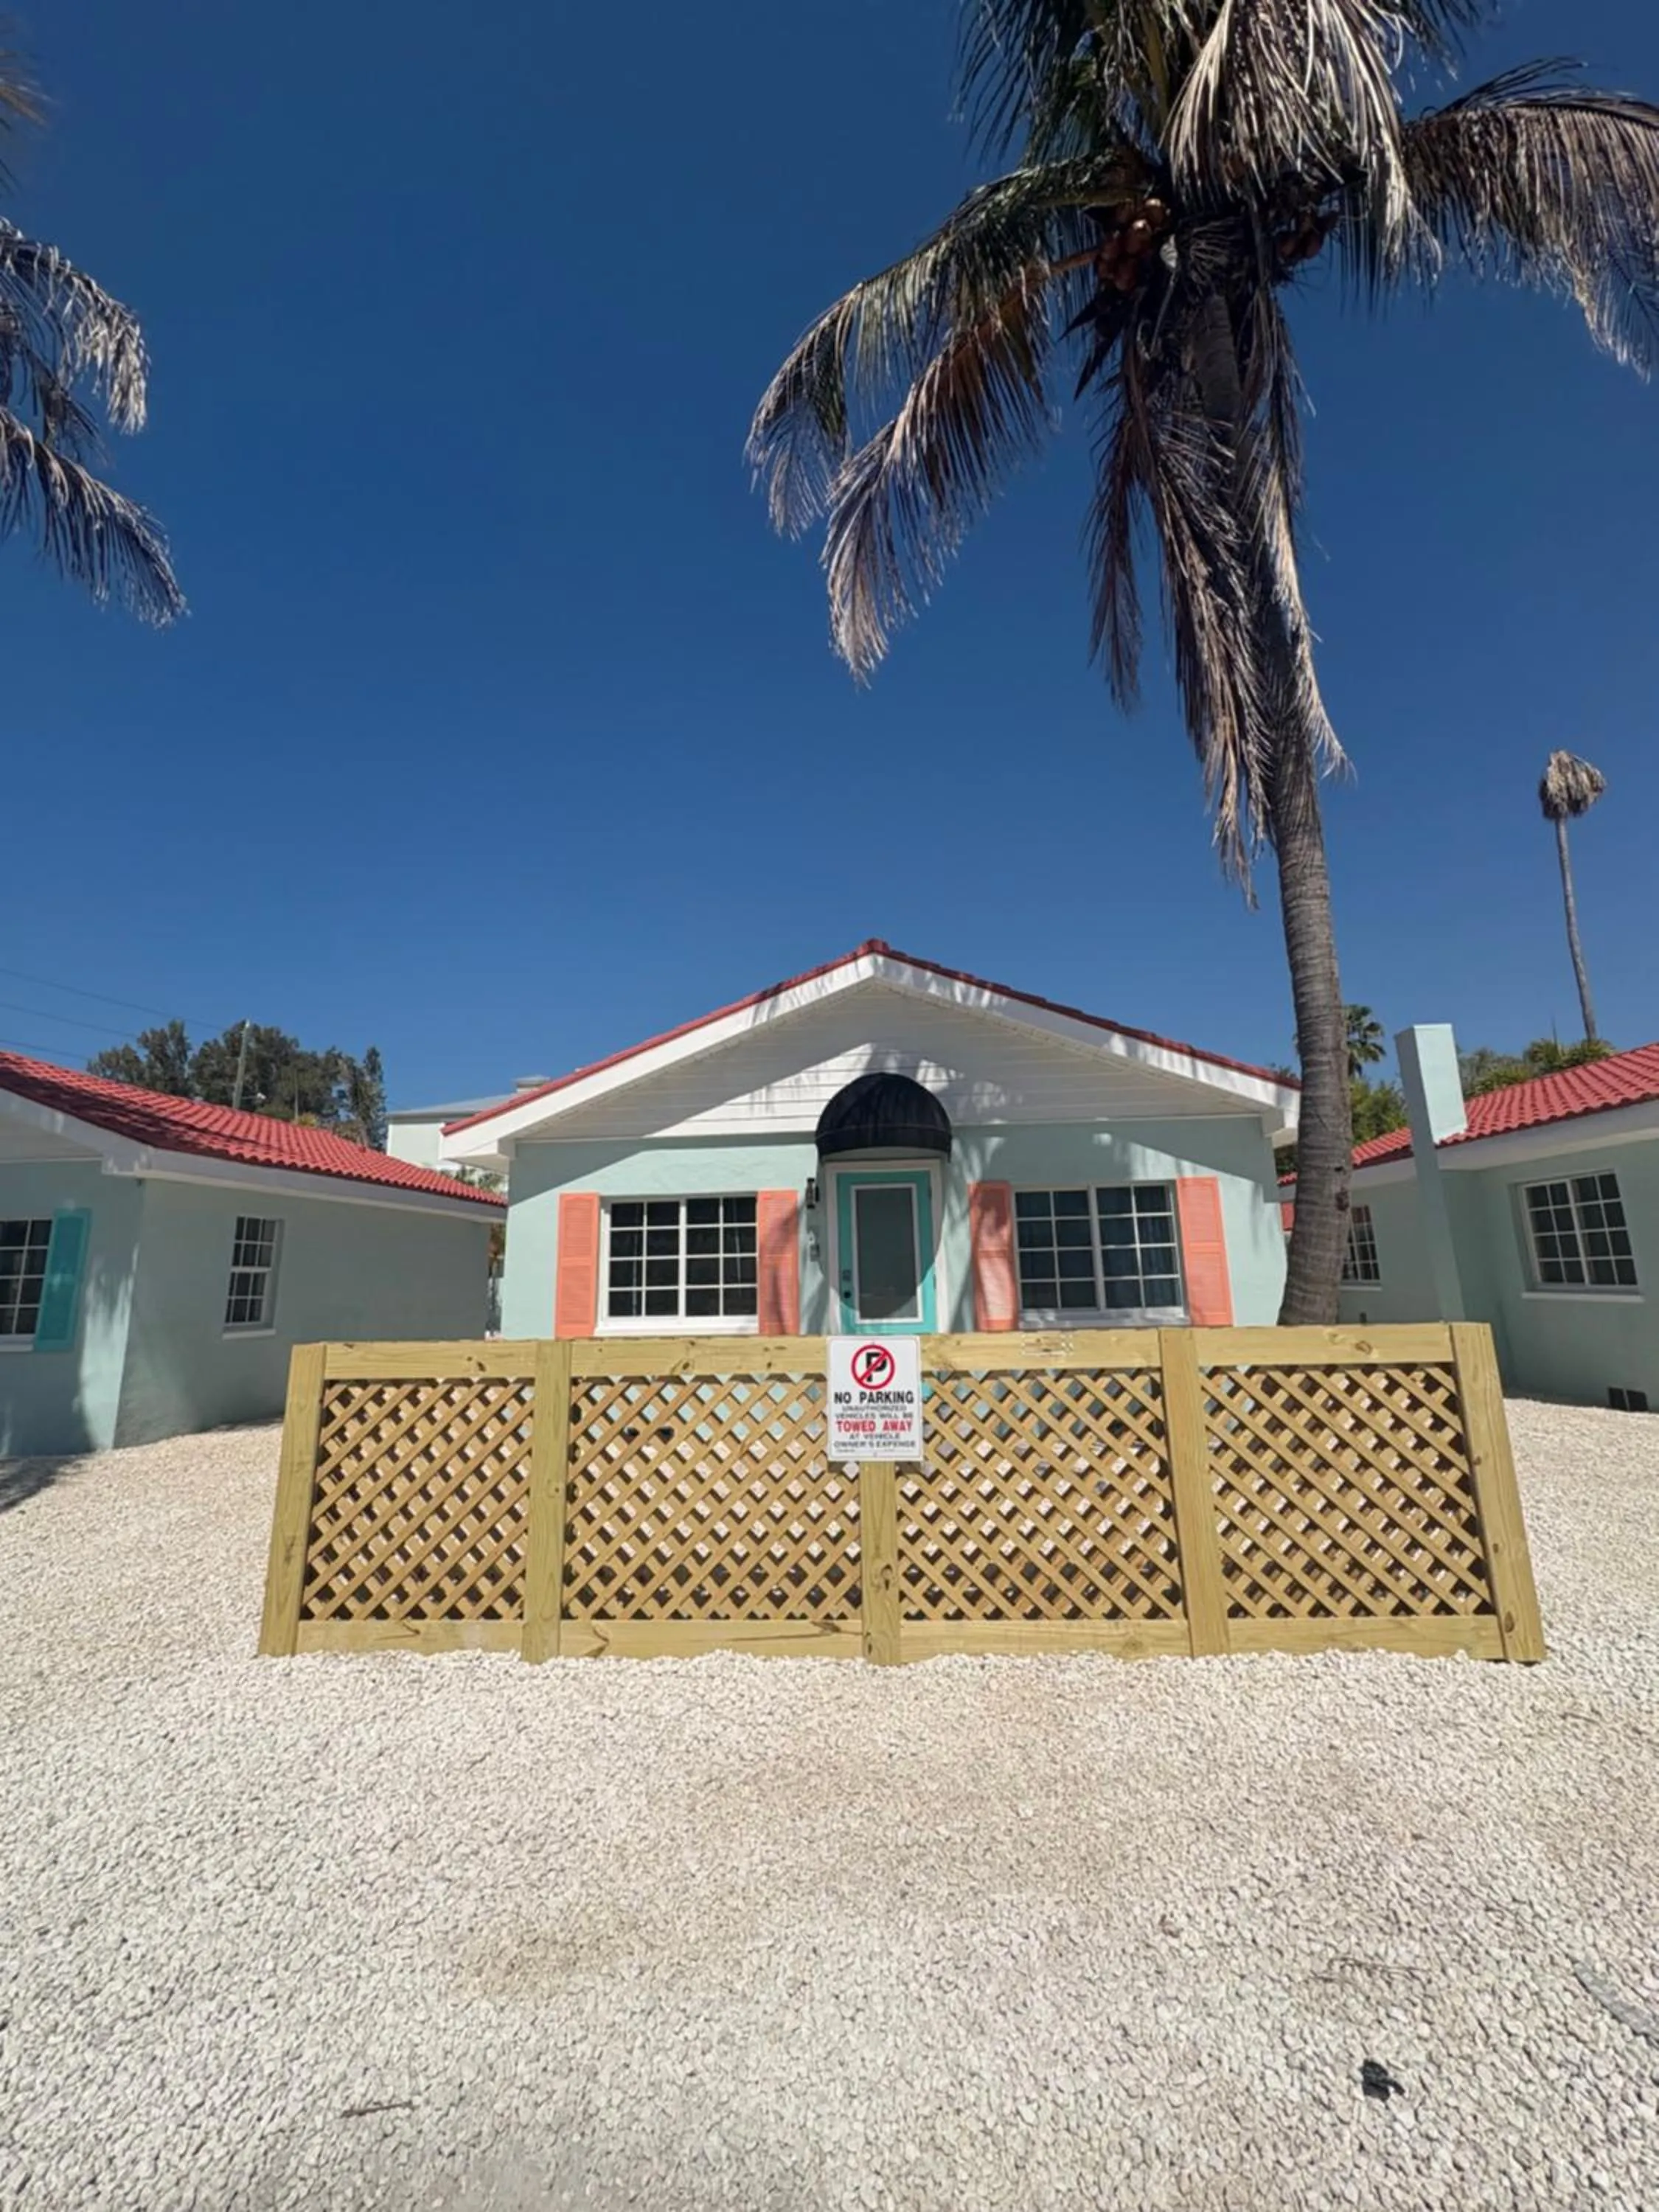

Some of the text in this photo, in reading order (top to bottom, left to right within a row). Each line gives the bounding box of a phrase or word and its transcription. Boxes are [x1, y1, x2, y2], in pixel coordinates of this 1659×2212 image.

[834, 1391, 914, 1403] NO PARKING
[836, 1420, 912, 1432] TOWED AWAY
